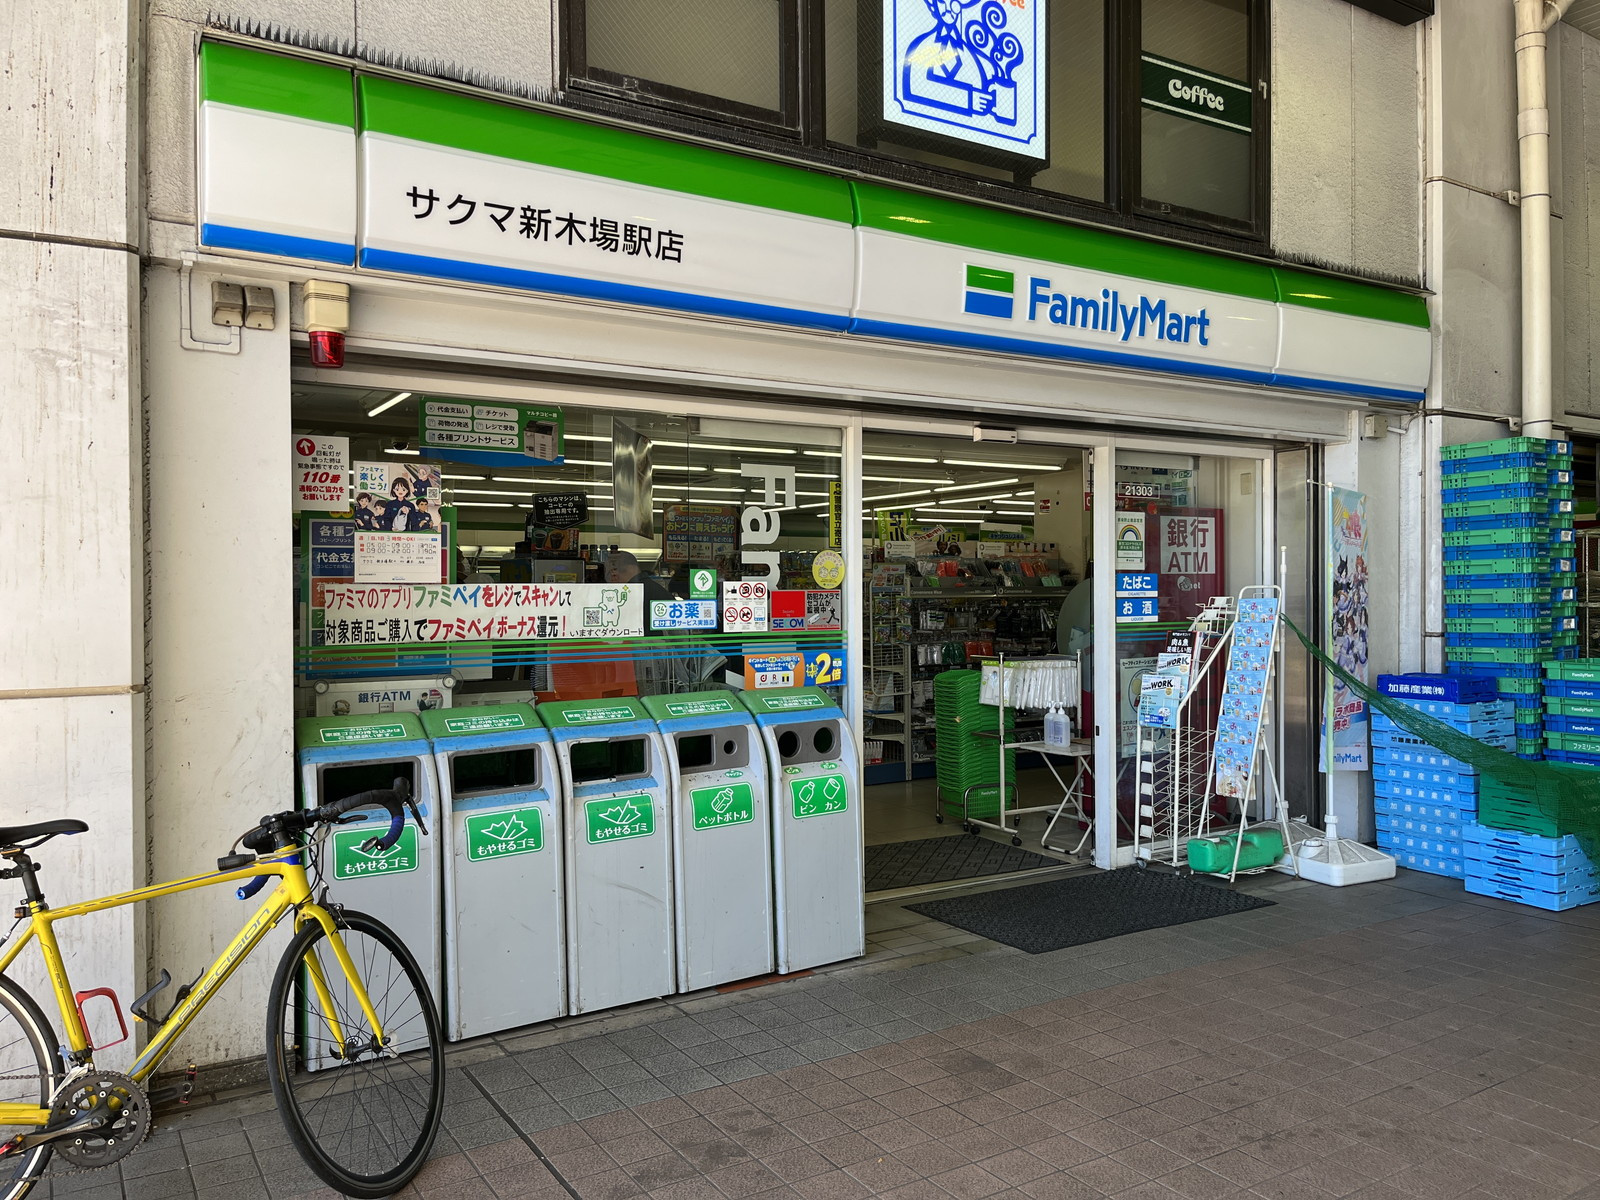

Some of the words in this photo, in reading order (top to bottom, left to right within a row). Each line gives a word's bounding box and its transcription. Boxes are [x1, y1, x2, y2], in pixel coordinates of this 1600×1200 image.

[1168, 78, 1225, 112] Coffee
[405, 185, 684, 263] サクマ新木場駅店
[1026, 276, 1210, 347] FamilyMart
[437, 406, 469, 415] 代金支払い
[485, 410, 509, 418] チケット
[437, 420, 469, 429] 荷物の発送
[485, 424, 515, 432] レジで受取
[437, 432, 516, 446] 各種プリントサービス
[297, 463, 345, 471] 緊急事態ですので
[302, 471, 342, 484] 110番
[359, 473, 385, 481] 楽しく
[298, 485, 345, 494] 通報のご協力を
[359, 482, 388, 491] 働こう!
[1125, 485, 1153, 497] 21303
[301, 493, 342, 502] お願いします
[1167, 518, 1210, 548] 銀行
[1167, 551, 1209, 573] ATM
[1122, 575, 1152, 590] たばこ
[806, 592, 840, 601] 防犯カメラで
[668, 602, 700, 619] お薬
[807, 606, 827, 614] 監視中
[1122, 600, 1153, 615] お酒
[676, 619, 715, 627] サービス実施店
[773, 618, 805, 629] SECOM
[569, 627, 644, 638] いますぐダウンロード
[1166, 657, 1190, 667] WORK
[1150, 680, 1174, 690] WORK
[1388, 683, 1445, 696] 加藤産業(株)
[357, 691, 412, 704] 銀行ATM
[1333, 700, 1363, 717] ラボ商品
[1334, 753, 1362, 764] ilyMart
[800, 804, 817, 815] ビン
[824, 800, 842, 811] カン
[698, 810, 749, 825] ペットボトル
[595, 823, 649, 840] もやせるゴミ
[476, 839, 536, 856] もやせるゴミ
[344, 857, 410, 874] もやせるゴミ
